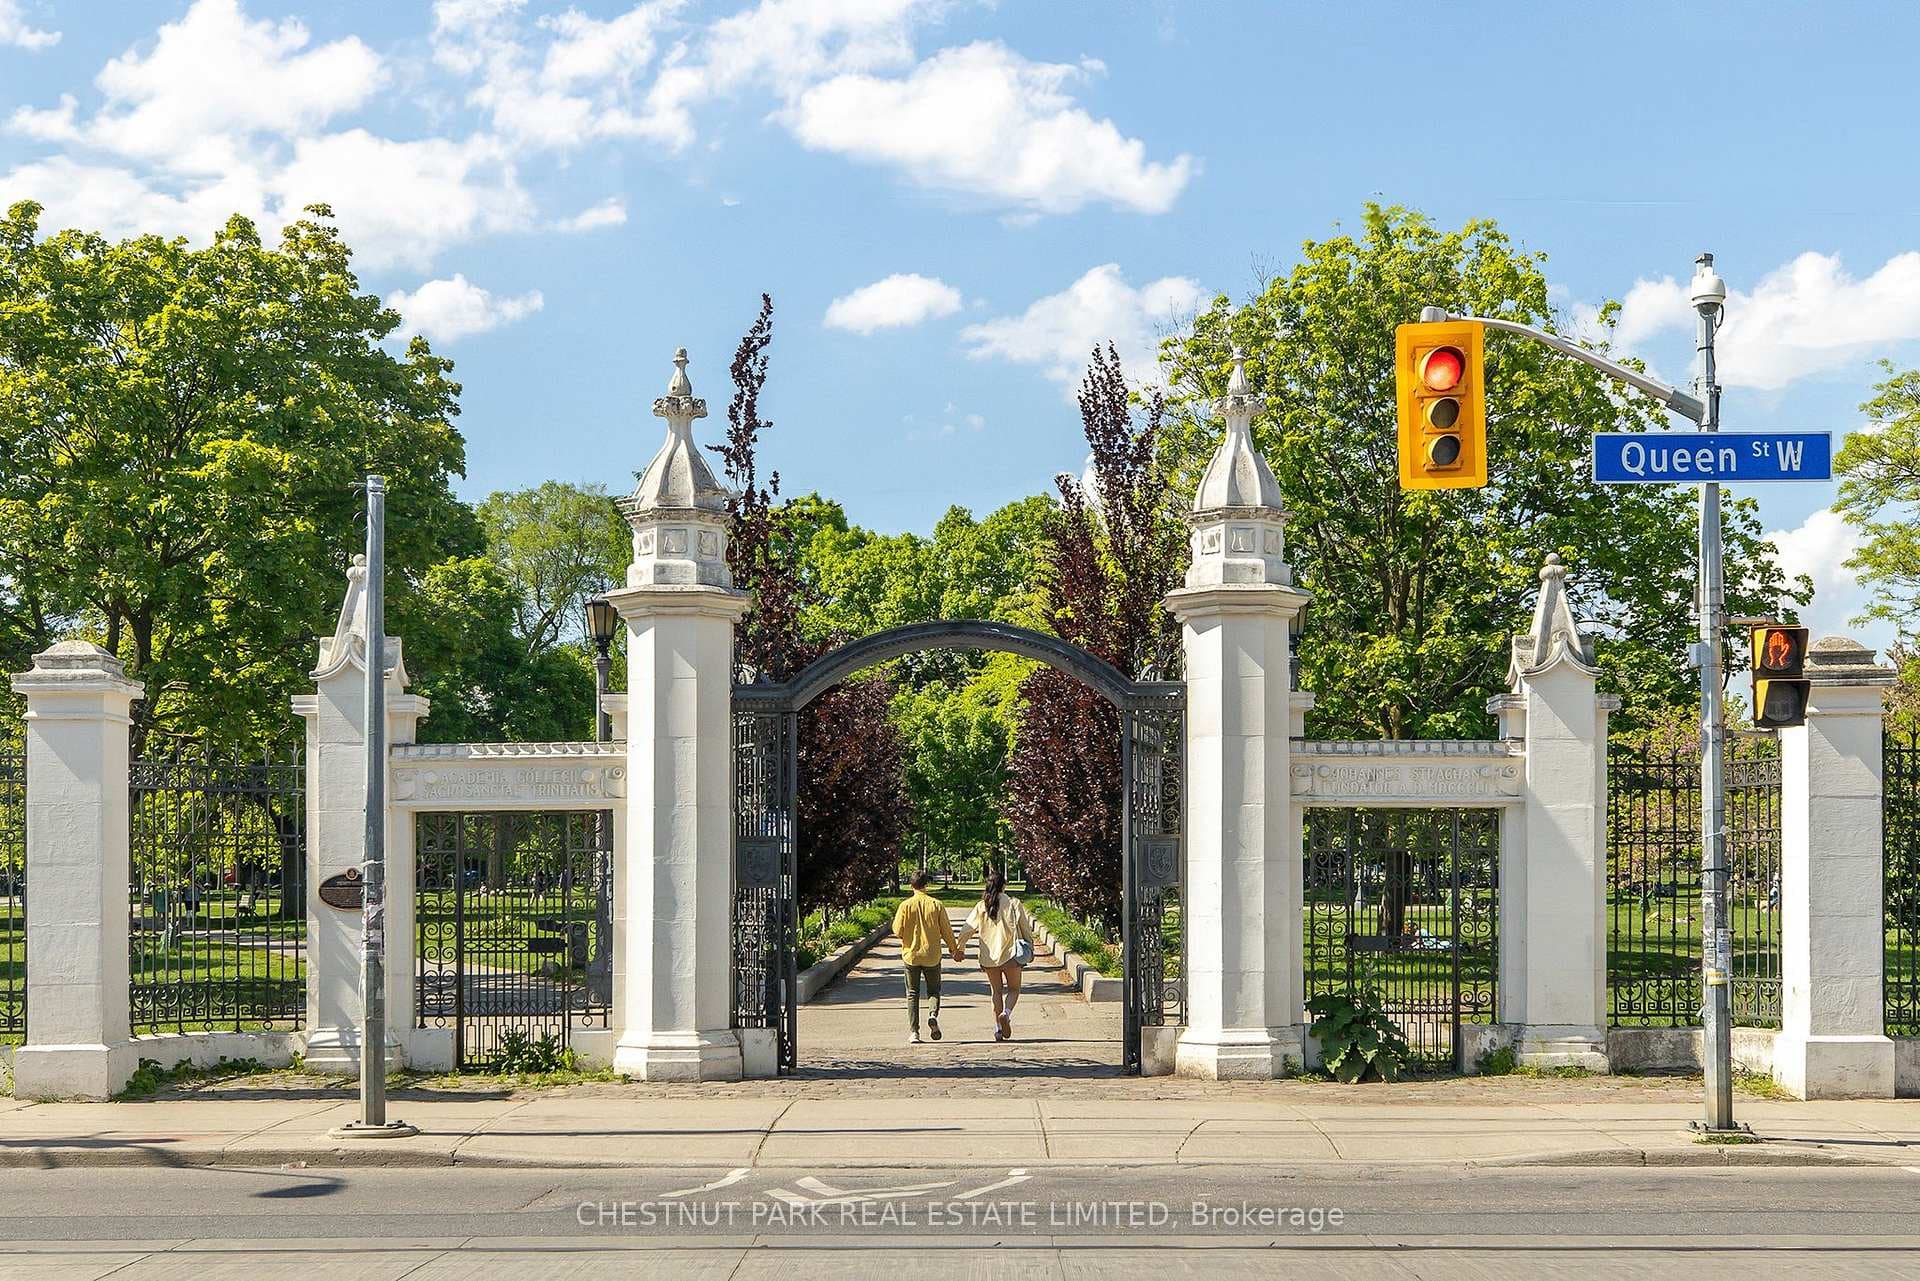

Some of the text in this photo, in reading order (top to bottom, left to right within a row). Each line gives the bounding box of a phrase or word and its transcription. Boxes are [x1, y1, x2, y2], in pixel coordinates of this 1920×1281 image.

[1621, 440, 1804, 477] Queen St W
[1332, 767, 1482, 781] JOHANNES STRACHAN
